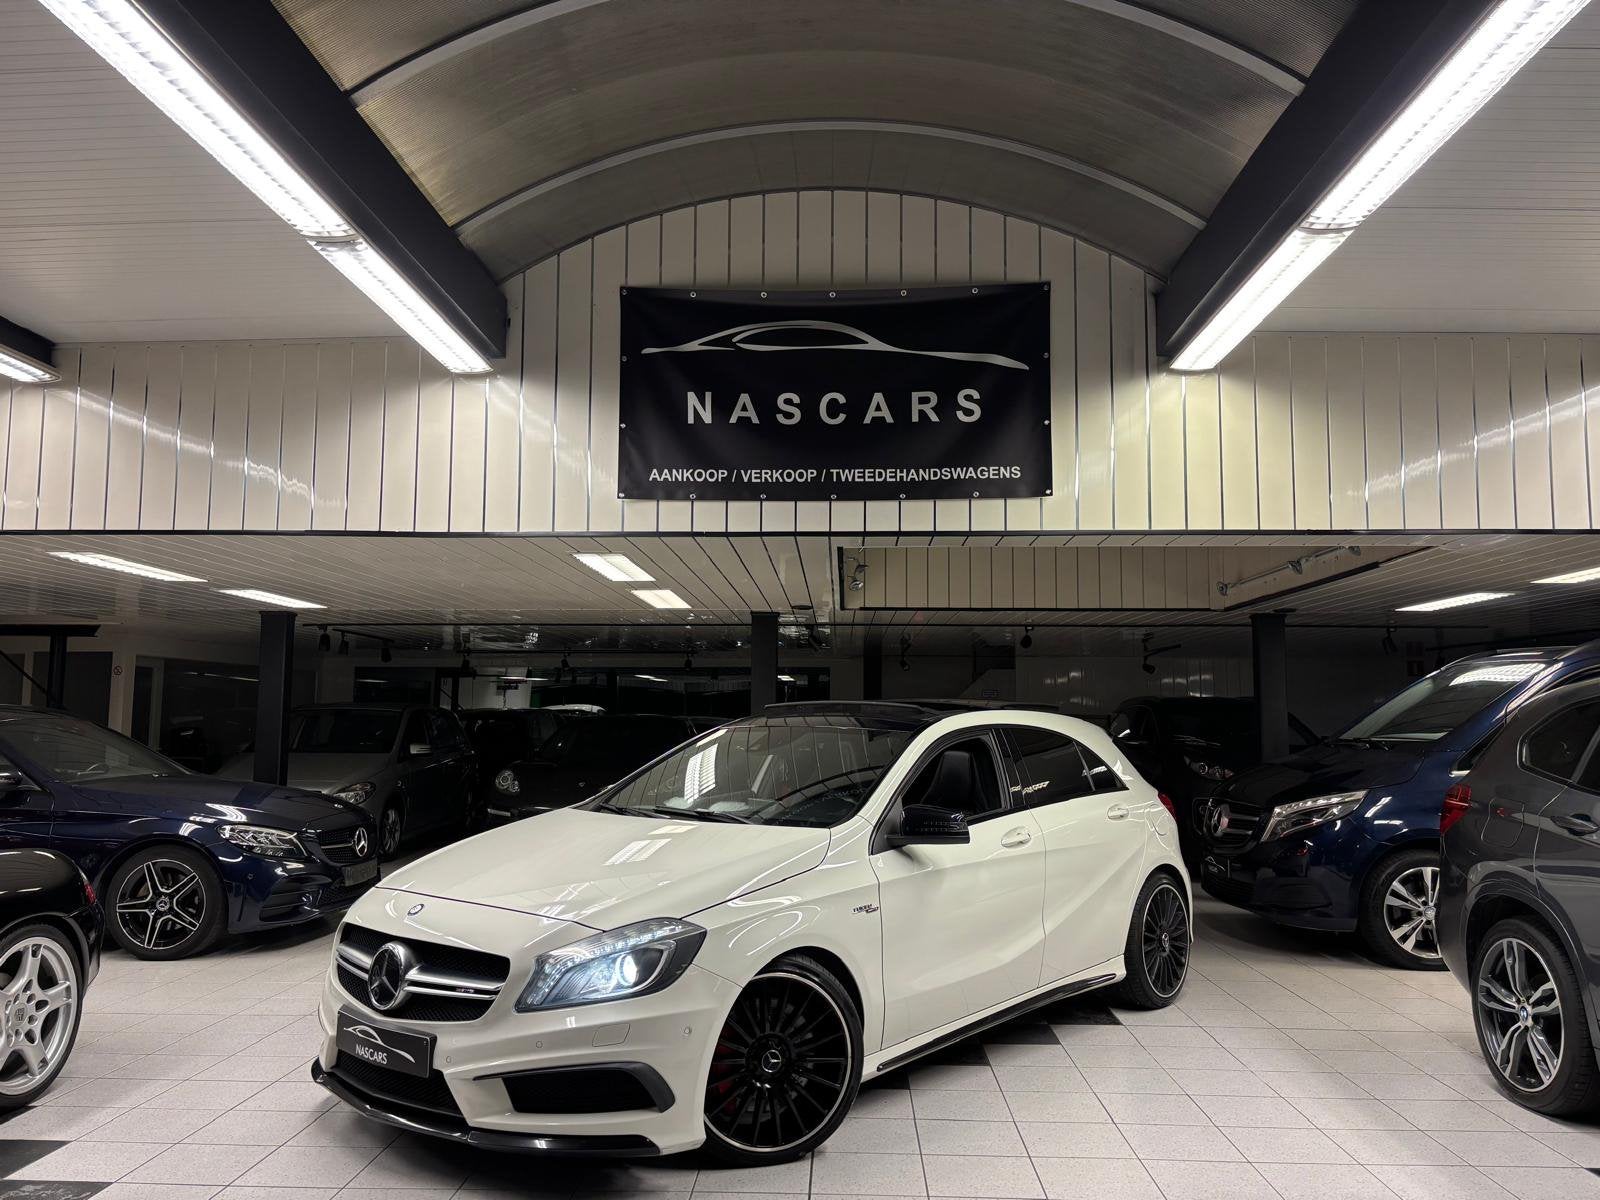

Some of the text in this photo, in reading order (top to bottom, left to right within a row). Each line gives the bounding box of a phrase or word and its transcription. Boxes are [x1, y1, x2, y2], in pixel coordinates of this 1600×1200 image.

[686, 388, 983, 426] NASCARS
[648, 466, 1022, 483] AANKOOP / VERKOOP / TWEEDEHANDSWAGENS
[355, 1043, 388, 1065] NASCARS
